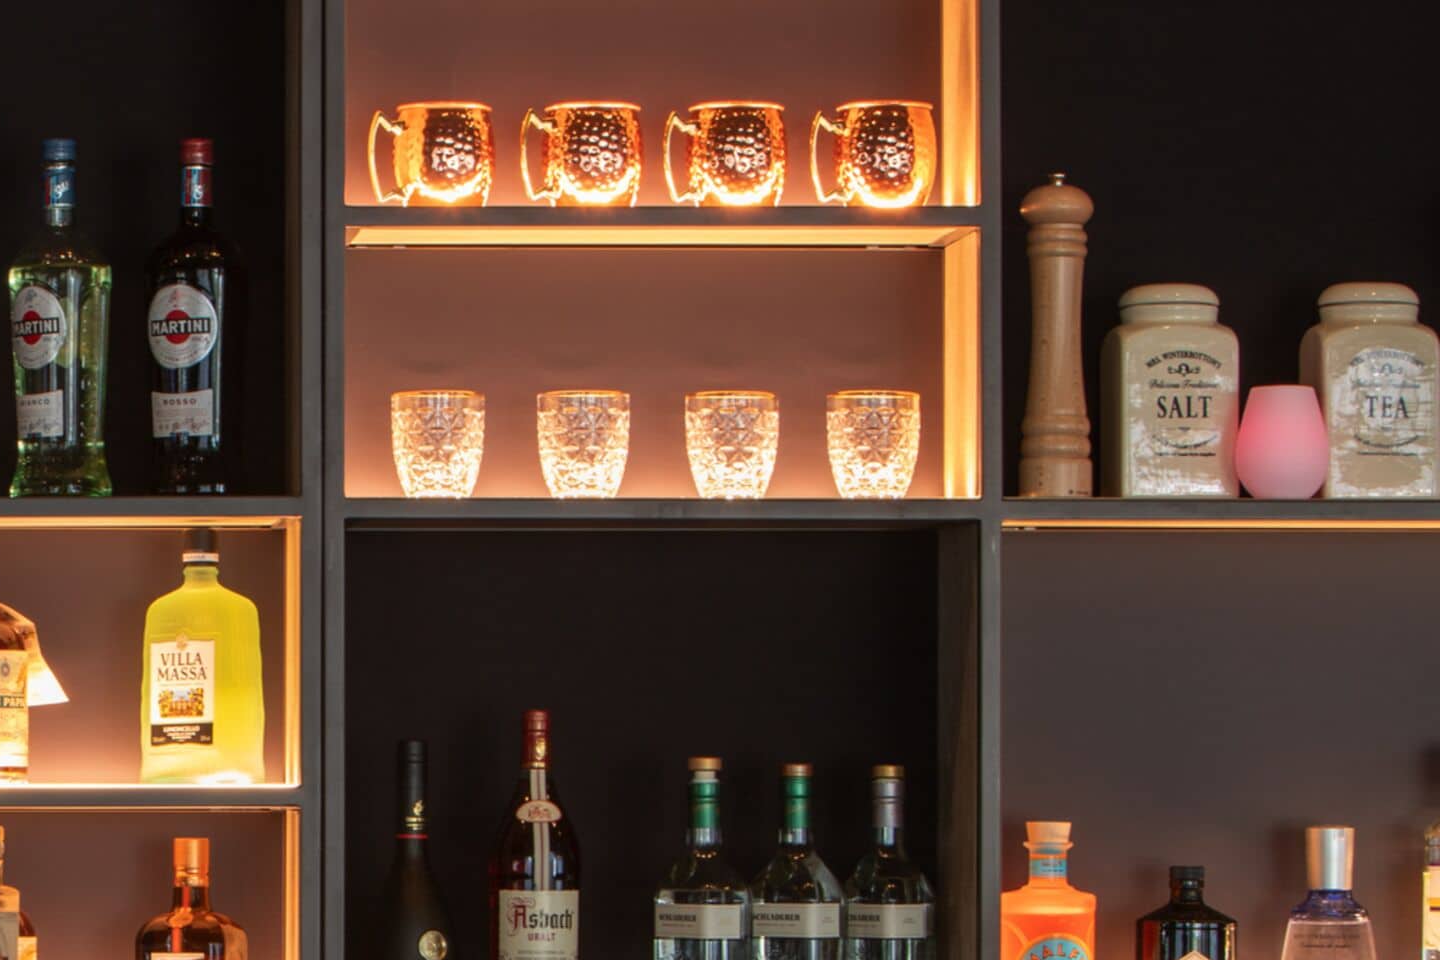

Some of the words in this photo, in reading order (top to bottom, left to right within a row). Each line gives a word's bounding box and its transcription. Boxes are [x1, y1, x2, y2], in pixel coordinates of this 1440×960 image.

[15, 319, 59, 336] MARTINI
[152, 318, 210, 336] MARTINI
[162, 398, 198, 406] ROSSO
[1156, 395, 1213, 419] SALT
[1365, 395, 1409, 419] TEA
[161, 652, 203, 667] VILLA
[158, 667, 207, 681] MASSA
[513, 903, 573, 932] Asbach
